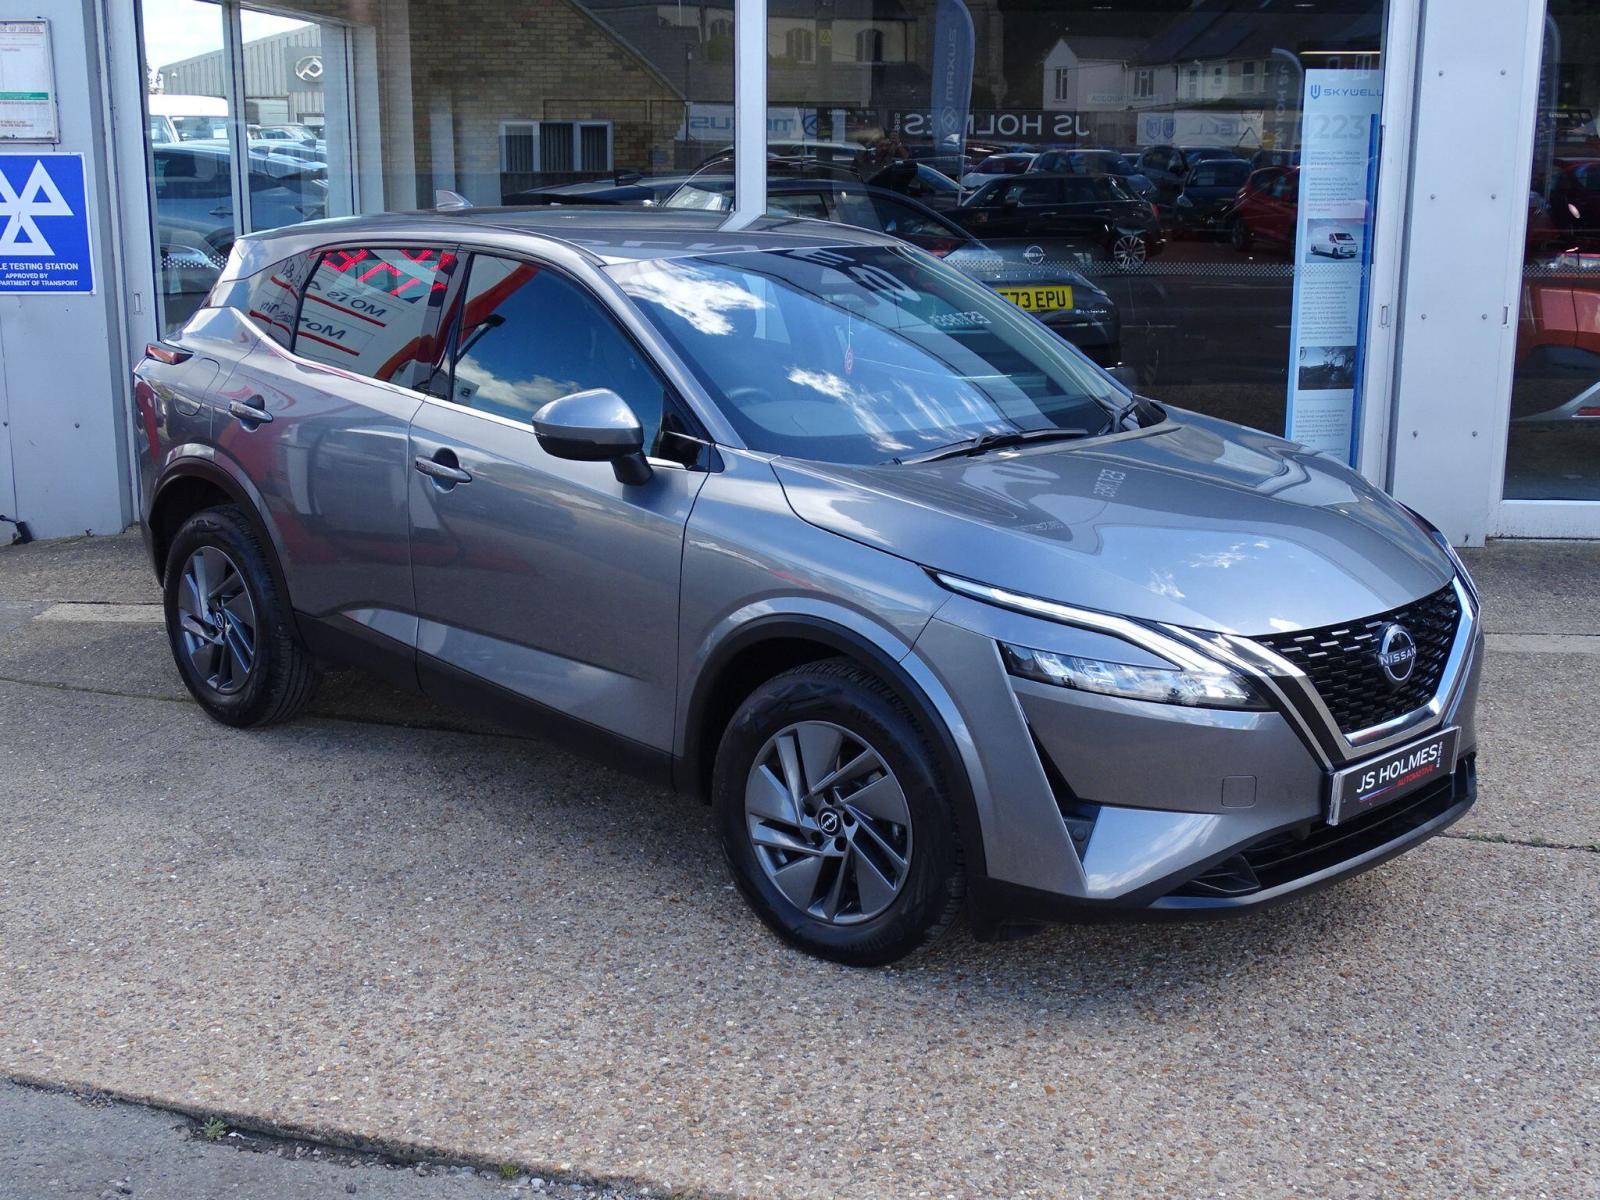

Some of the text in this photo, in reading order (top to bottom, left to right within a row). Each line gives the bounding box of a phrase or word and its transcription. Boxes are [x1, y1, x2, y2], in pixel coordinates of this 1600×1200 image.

[1323, 88, 1383, 97] SKYWELL
[9, 262, 43, 270] TESTING
[45, 262, 79, 270] STATION
[1000, 290, 1067, 308] 73 EPU
[1379, 645, 1417, 666] NISSAN
[1356, 771, 1377, 794] JS
[1378, 743, 1438, 785] HOLMES
